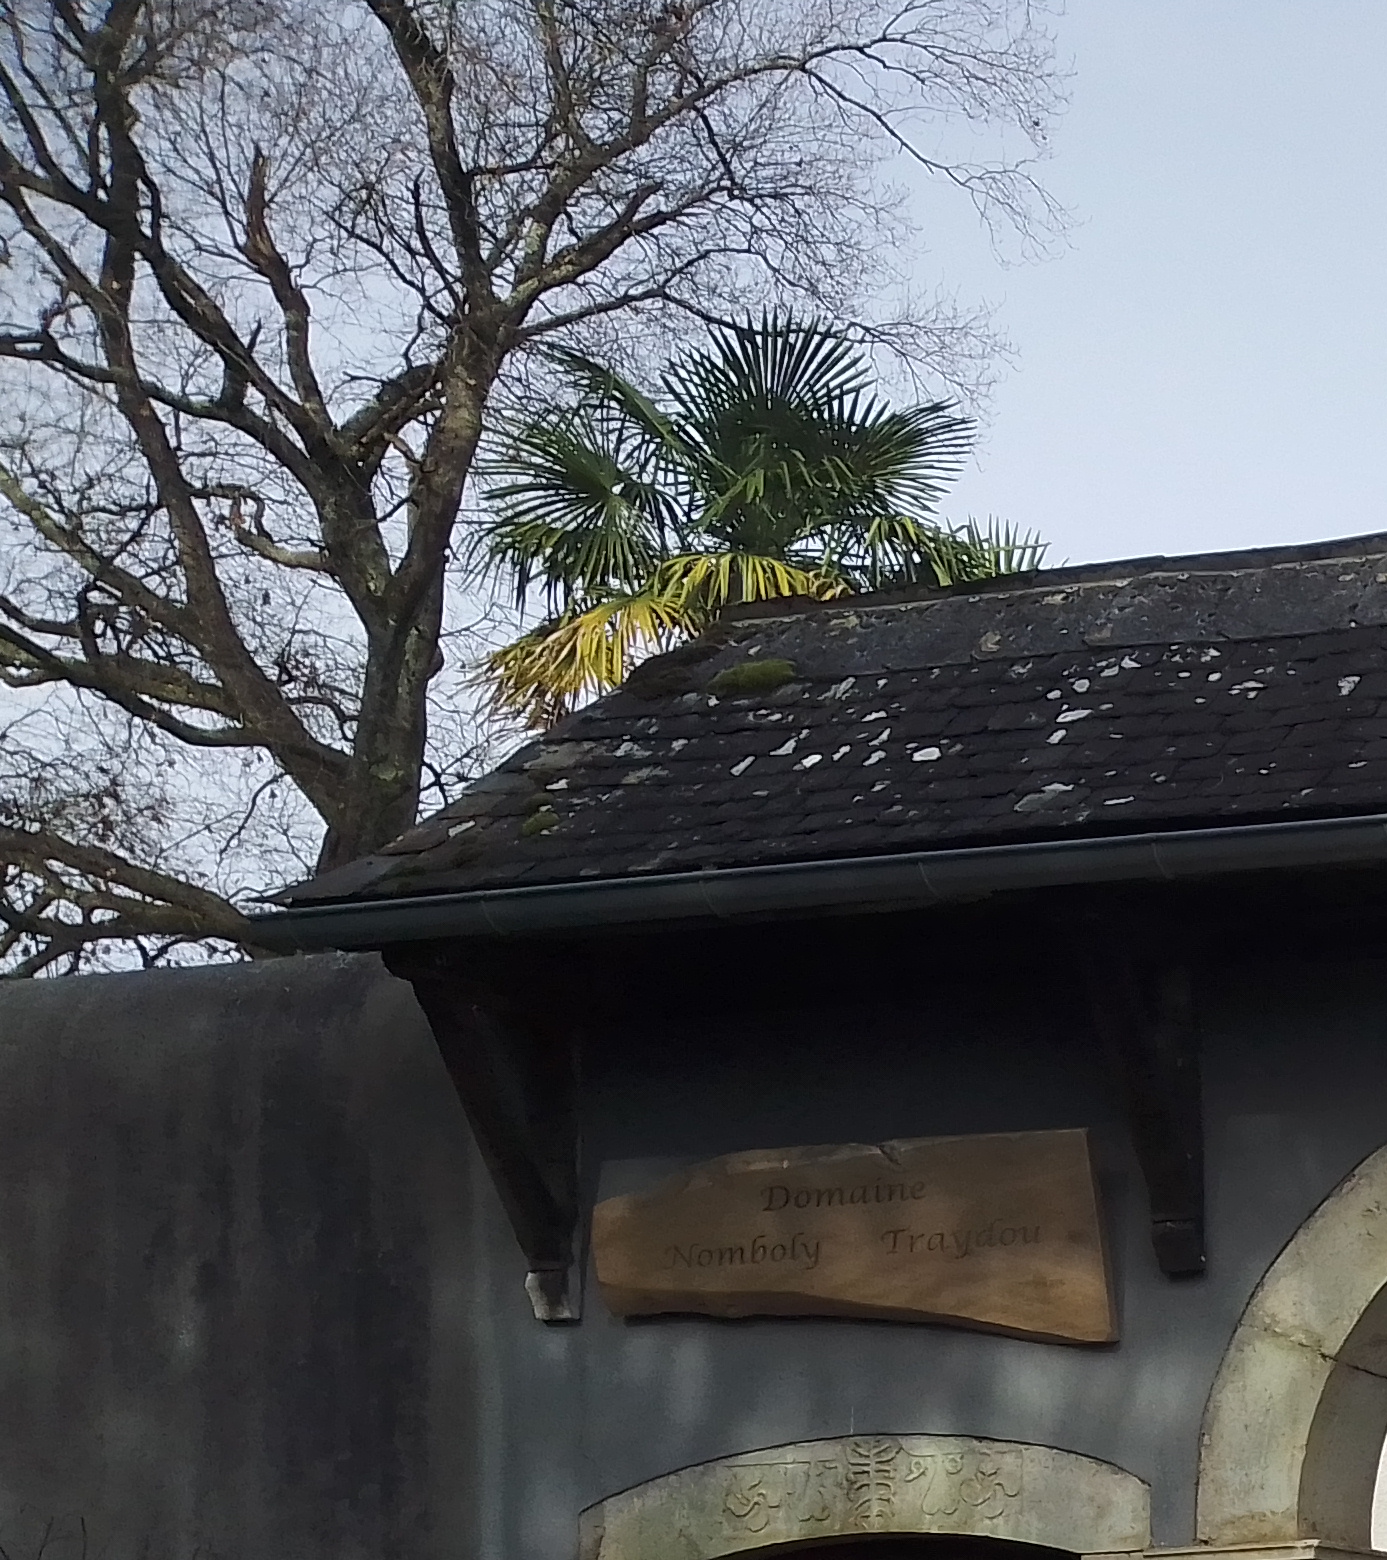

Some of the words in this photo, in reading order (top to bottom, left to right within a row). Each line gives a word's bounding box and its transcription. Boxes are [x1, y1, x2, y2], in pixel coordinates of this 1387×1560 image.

[760, 1177, 926, 1212] Domaine
[664, 1232, 823, 1270] Nomboly
[881, 1219, 1042, 1259] Traydou
